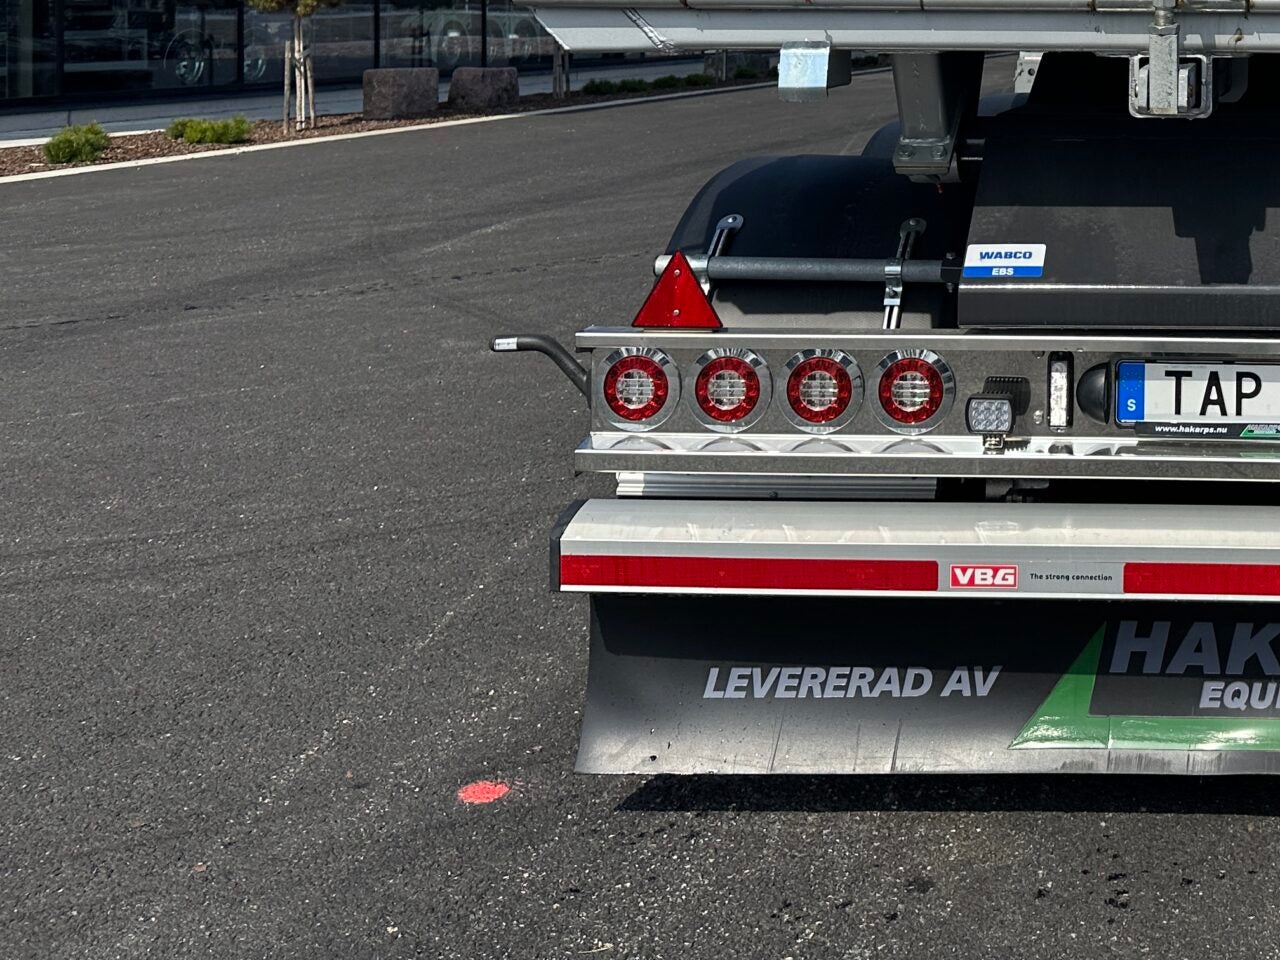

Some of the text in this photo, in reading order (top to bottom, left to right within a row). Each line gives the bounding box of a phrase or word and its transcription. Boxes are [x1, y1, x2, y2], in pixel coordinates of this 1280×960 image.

[979, 251, 1033, 260] WABCO
[992, 267, 1014, 276] EBS
[1164, 370, 1262, 416] TAP
[1127, 398, 1136, 411] S
[1155, 425, 1228, 434] www.hakarps.nu
[953, 568, 1016, 585] VBG
[1045, 574, 1070, 582] strong
[702, 665, 1003, 699] LEVERERAD AV
